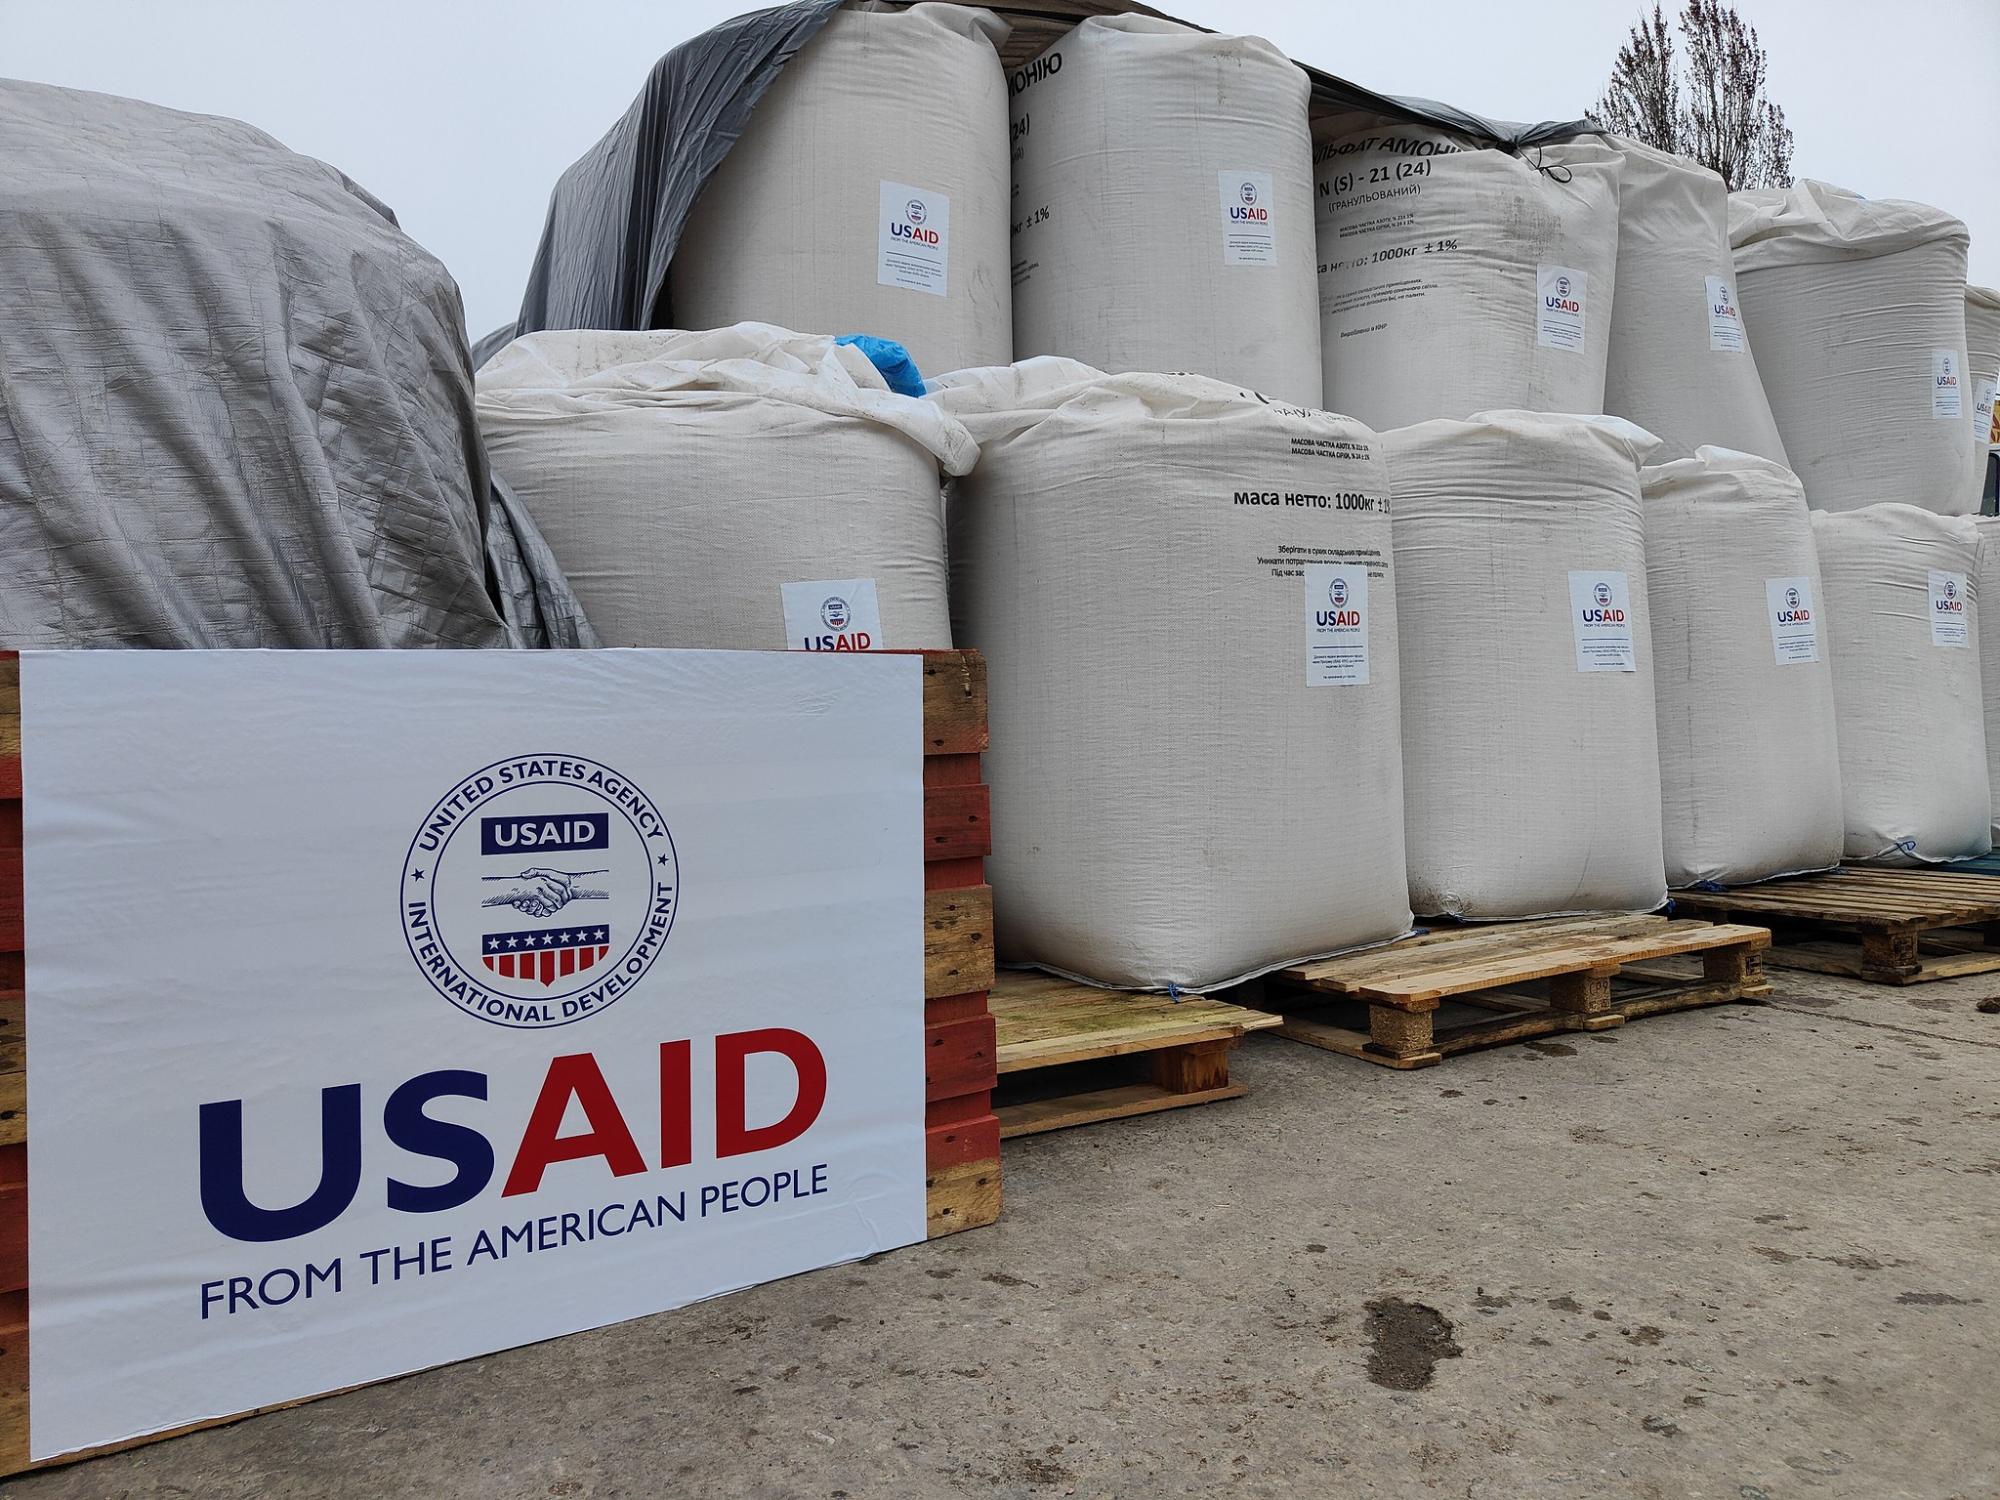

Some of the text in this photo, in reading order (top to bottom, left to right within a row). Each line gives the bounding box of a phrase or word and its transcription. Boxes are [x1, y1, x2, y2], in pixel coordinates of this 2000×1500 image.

[1319, 182, 1330, 198] N
[1334, 172, 1353, 195] (S)
[1369, 166, 1390, 184] 21
[1396, 159, 1432, 181] (24)
[1328, 184, 1421, 214] (ГРАНУЛЬОВАНИЙ)
[1034, 205, 1050, 225] 1%
[1229, 206, 1268, 221] USAID
[890, 222, 940, 244] USAID
[1371, 246, 1418, 264] 1000кг
[1424, 242, 1433, 254] ±
[1437, 239, 1458, 252] 1%
[1546, 296, 1580, 313] USAID
[1936, 376, 1957, 386] USAID
[1290, 438, 1315, 447] МАСОВА
[1315, 440, 1335, 449] ЧАСТКА
[1291, 447, 1316, 456] МАСОВА
[1315, 449, 1336, 458] ЧАСТКА
[1233, 492, 1280, 506] маса
[1284, 492, 1331, 509] нетто:
[1335, 492, 1375, 511] 1000кг
[1377, 497, 1383, 512] ±
[1278, 545, 1307, 555] Зберігати
[1257, 556, 1285, 565] Уникати
[1271, 568, 1283, 578] Під
[1283, 569, 1295, 577] час
[1935, 600, 1963, 612] USAID
[1316, 610, 1360, 627] USAID
[1582, 609, 1625, 623] USAID
[1777, 609, 1810, 623] USAID
[804, 632, 871, 651] USAID
[418, 760, 664, 852] UNITED STATES AGENCY
[495, 821, 596, 847] USAID
[408, 882, 673, 1022] INTERNATIONAL DEVELOPMENT
[200, 1027, 828, 1243] USAID
[201, 1164, 829, 1320] FROM THE AMERICAN PEOPLE
